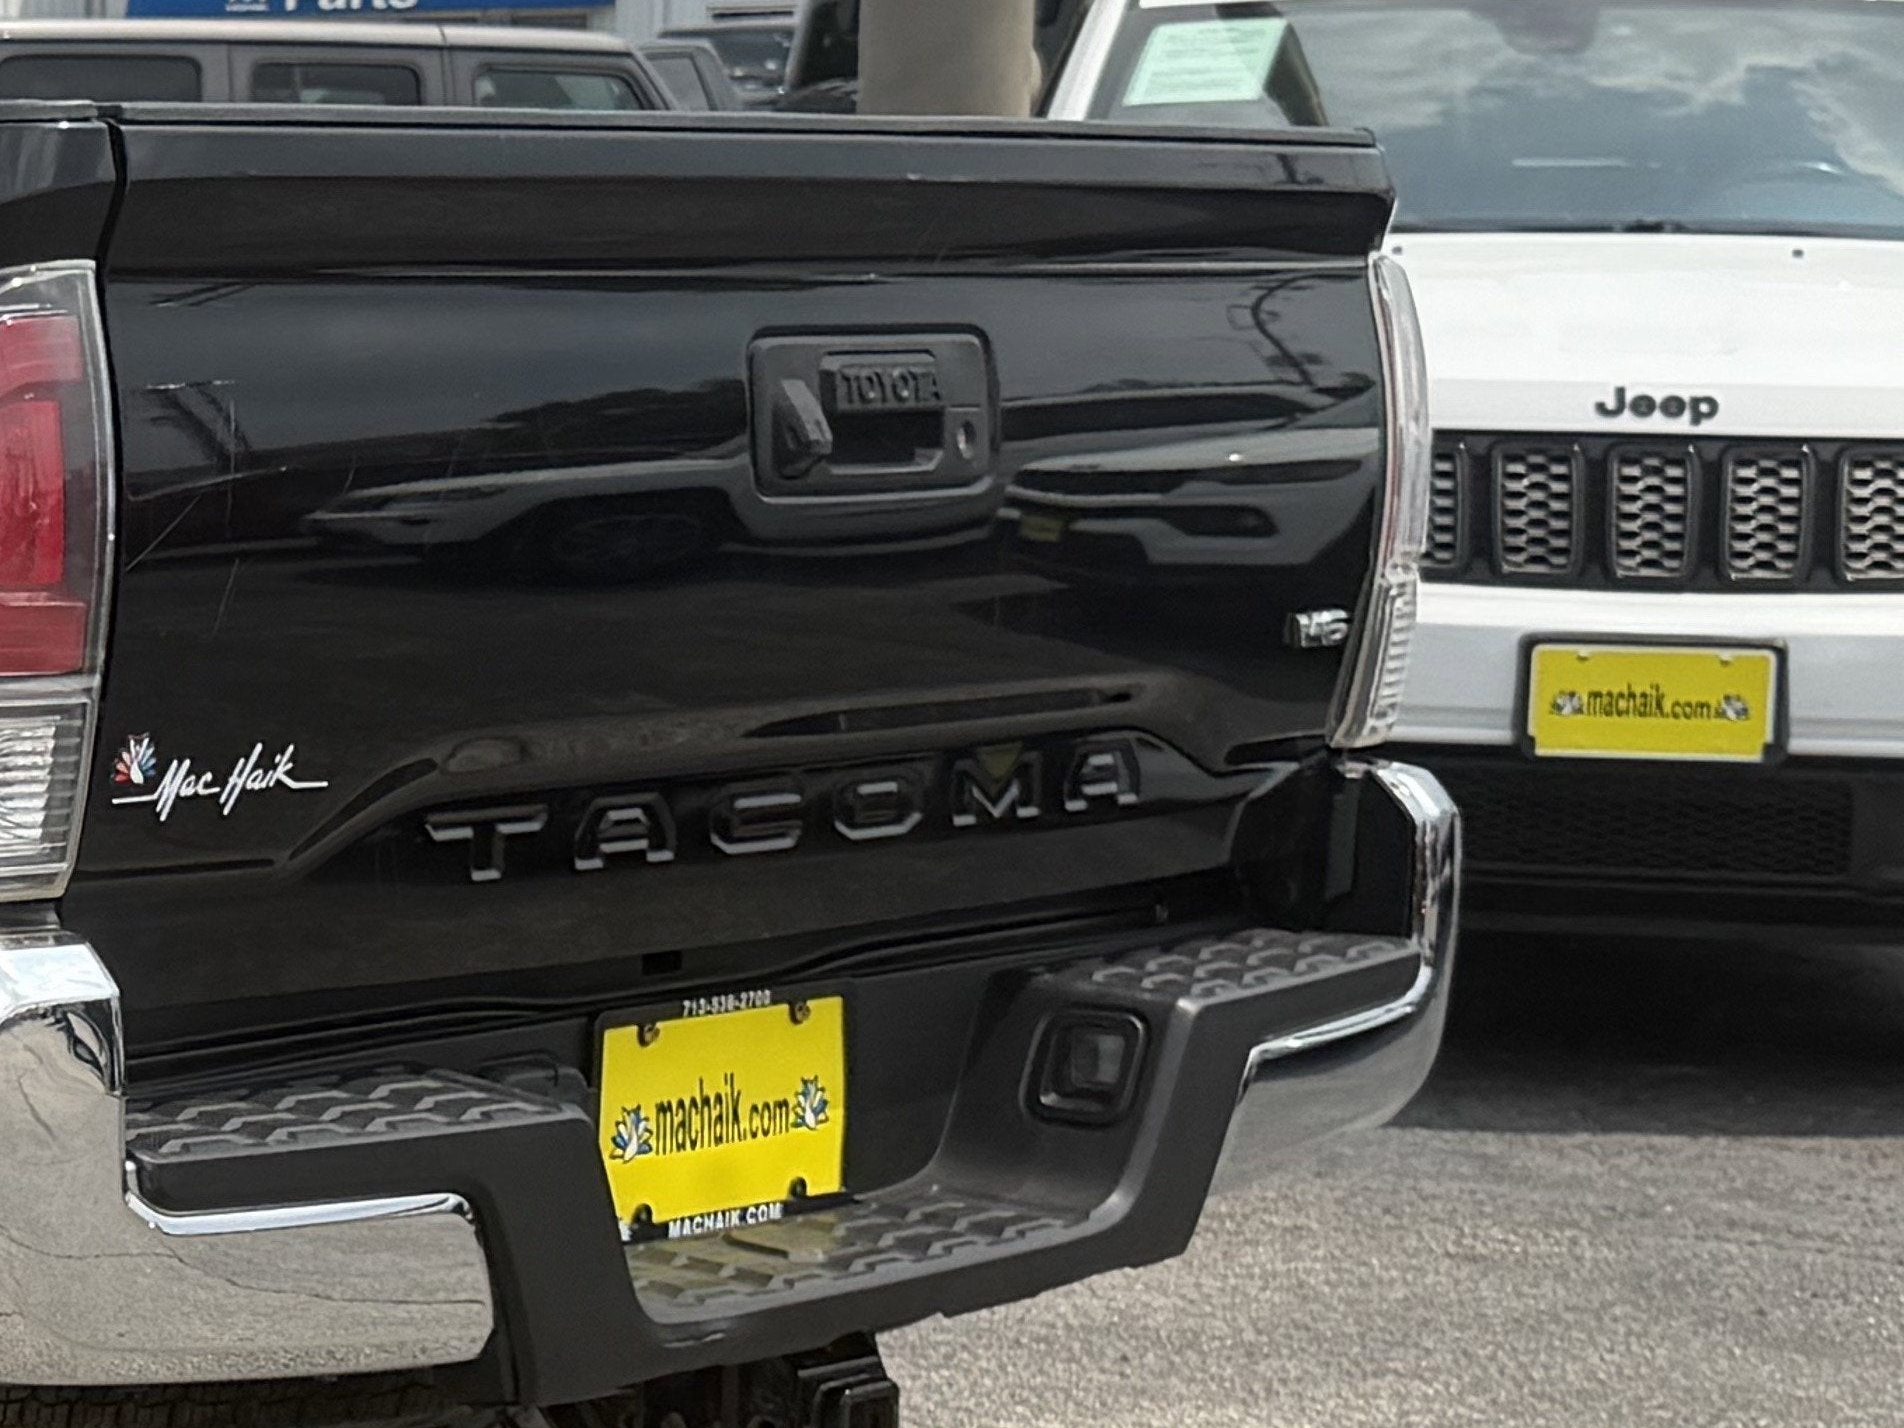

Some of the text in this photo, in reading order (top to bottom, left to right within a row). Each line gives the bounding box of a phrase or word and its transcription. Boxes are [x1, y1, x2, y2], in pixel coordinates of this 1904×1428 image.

[1595, 386, 1719, 425] Jeep
[1586, 683, 1713, 722] machaik.com
[112, 742, 328, 822] Mac Haik
[425, 735, 1143, 883] TACOMA
[654, 1073, 791, 1156] machaik.com
